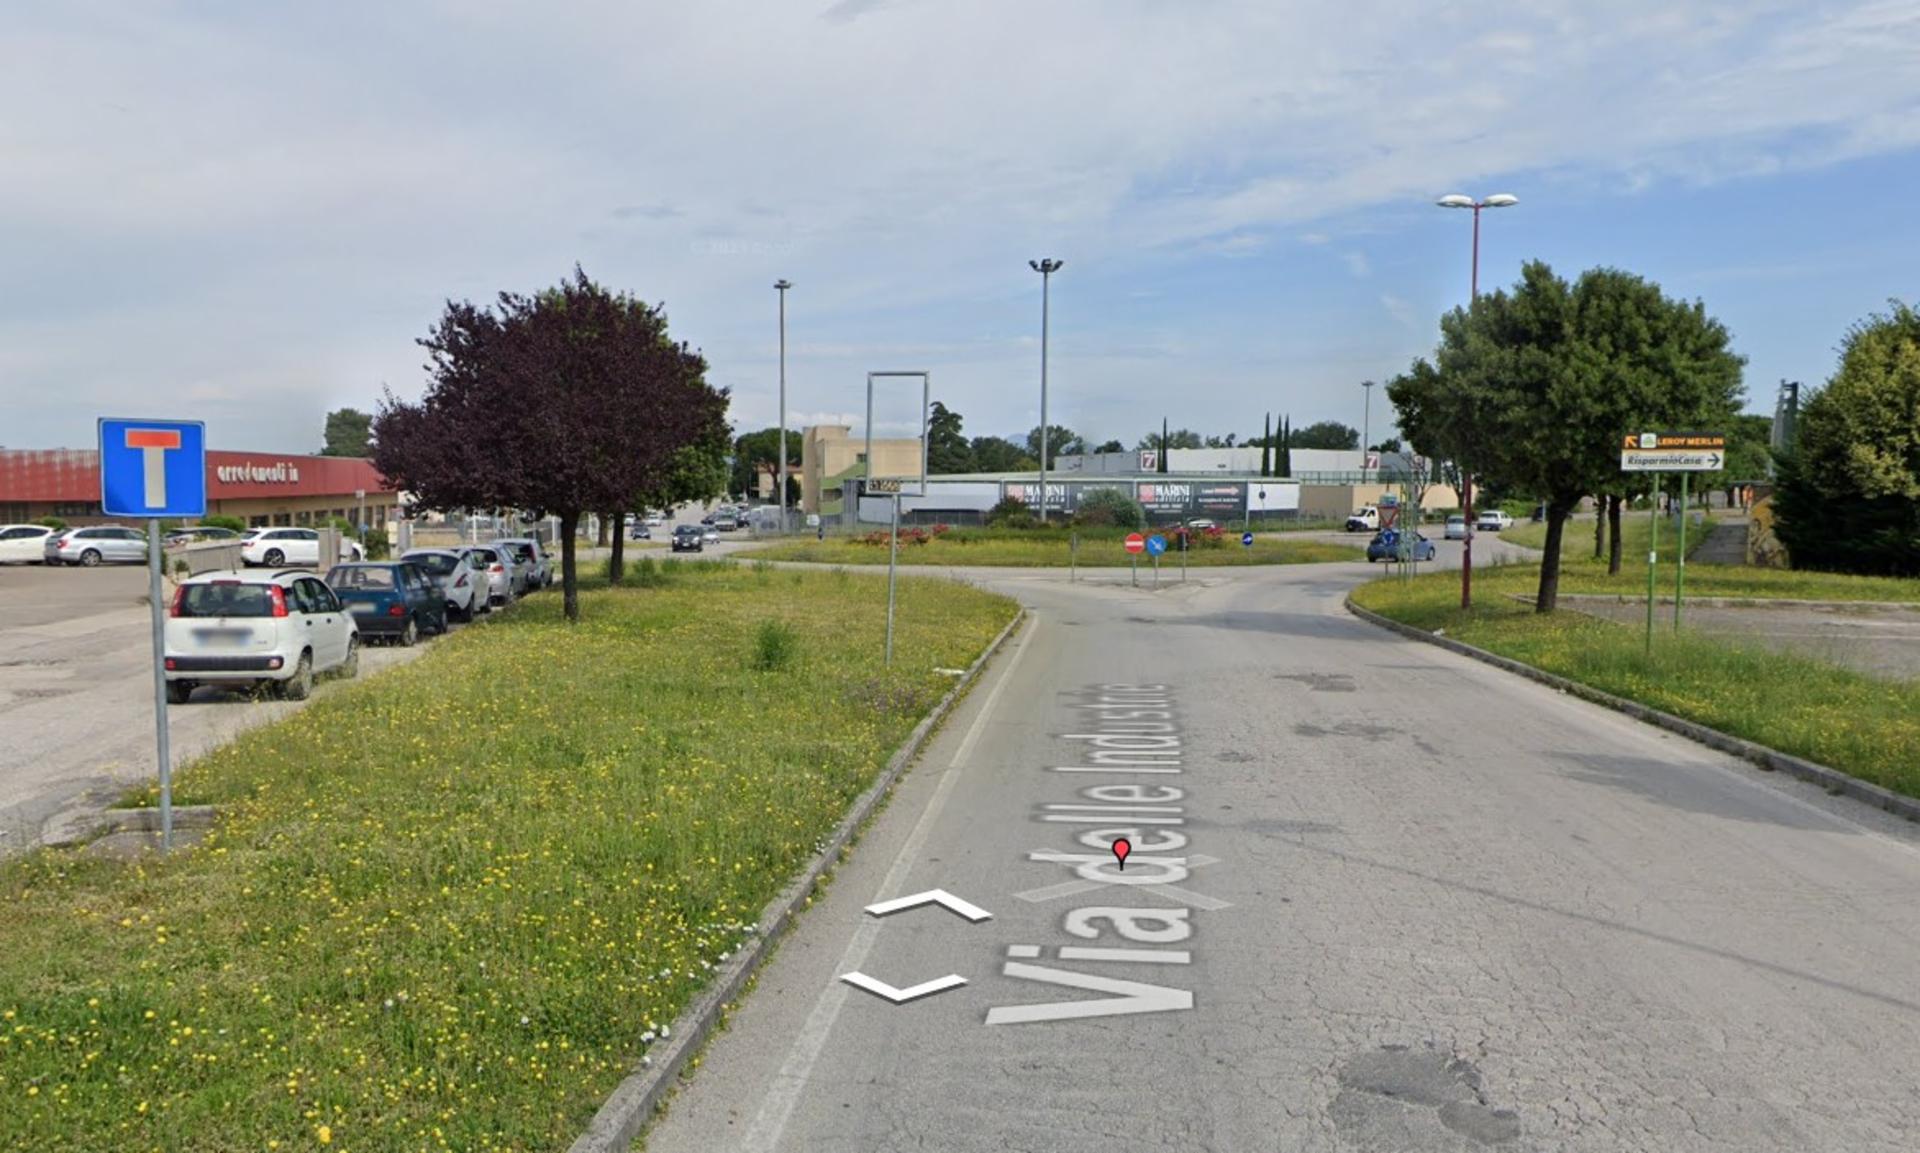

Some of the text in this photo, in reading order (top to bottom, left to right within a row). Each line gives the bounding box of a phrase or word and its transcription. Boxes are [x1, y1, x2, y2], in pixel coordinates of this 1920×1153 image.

[1657, 436, 1724, 446] LEROY MERLIN
[1627, 455, 1703, 467] RisparmioCasa
[1024, 484, 1065, 496] MARINI
[1155, 484, 1190, 496] MARINI
